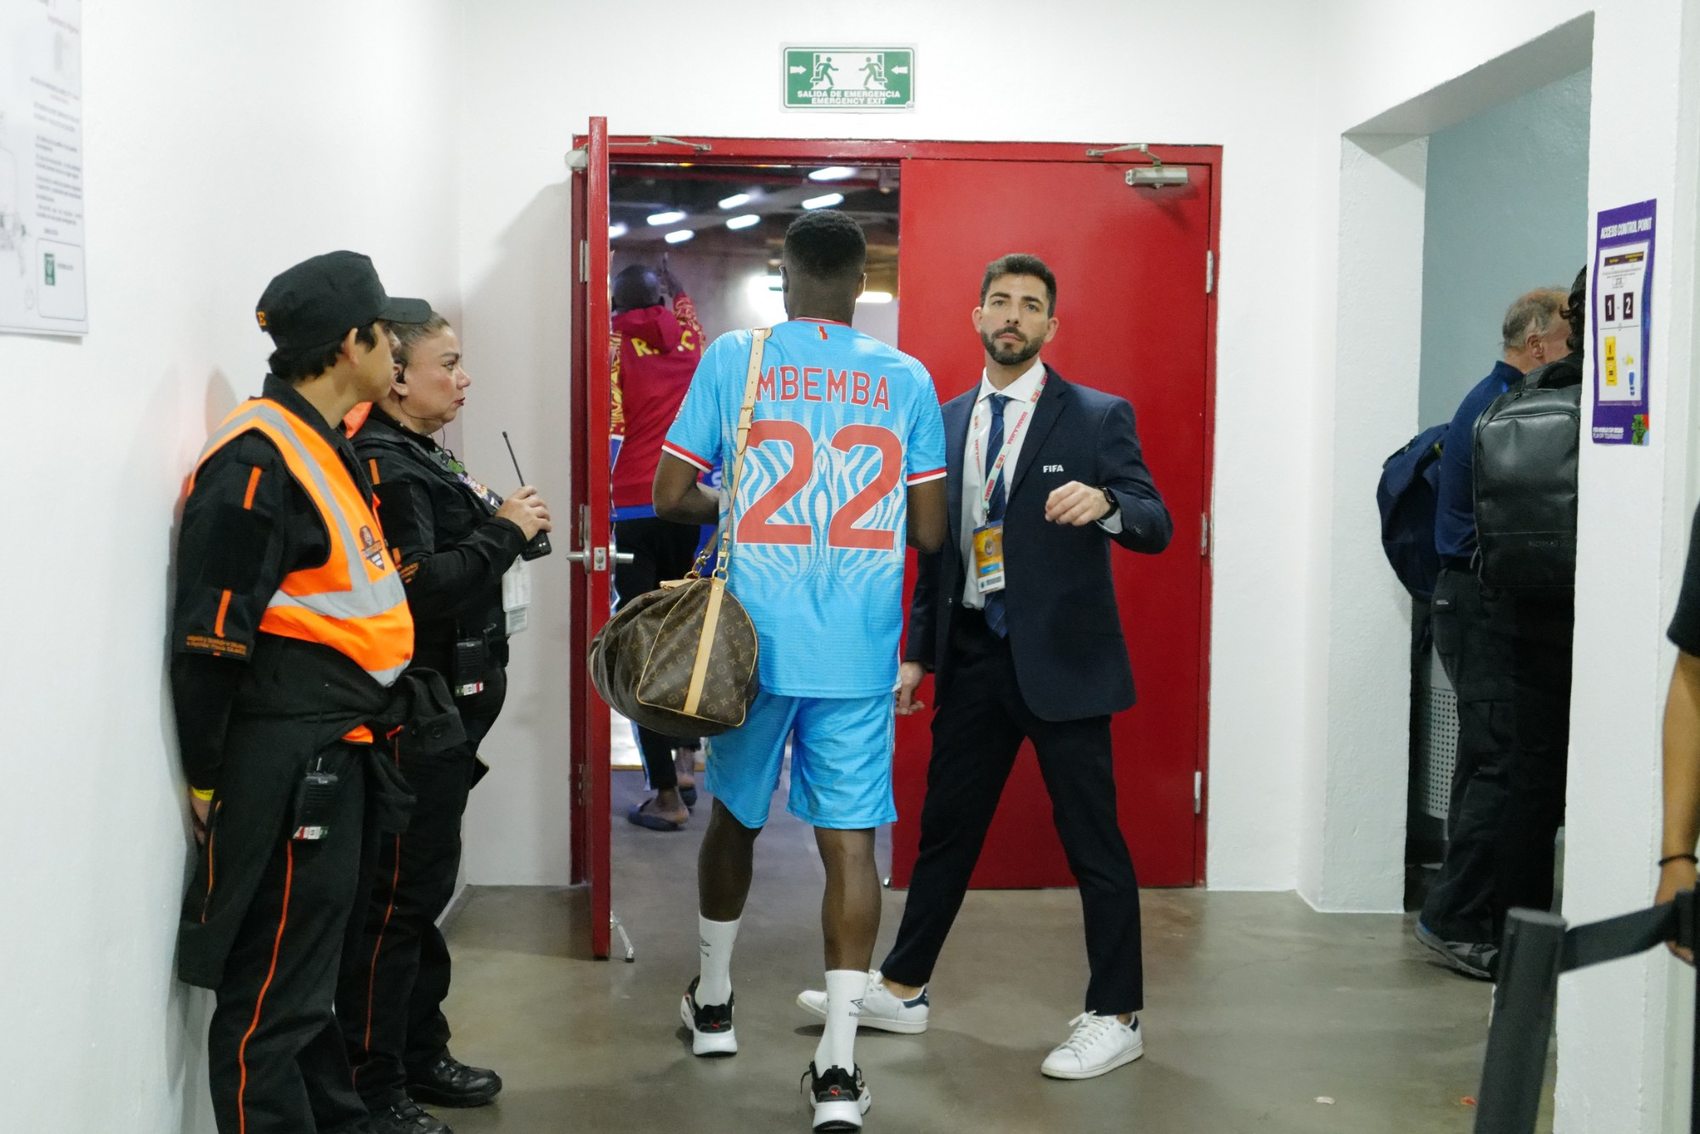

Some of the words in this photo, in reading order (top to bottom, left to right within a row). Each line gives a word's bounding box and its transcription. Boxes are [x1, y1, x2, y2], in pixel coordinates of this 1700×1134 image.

[797, 90, 827, 98] SALIDA
[830, 90, 842, 98] DE
[844, 90, 901, 98] EMERGENCIA
[1607, 300, 1612, 316] 1
[1625, 296, 1631, 315] 2
[755, 365, 890, 411] MBEMBA
[1043, 464, 1064, 473] FIFA
[736, 419, 902, 550] 22
